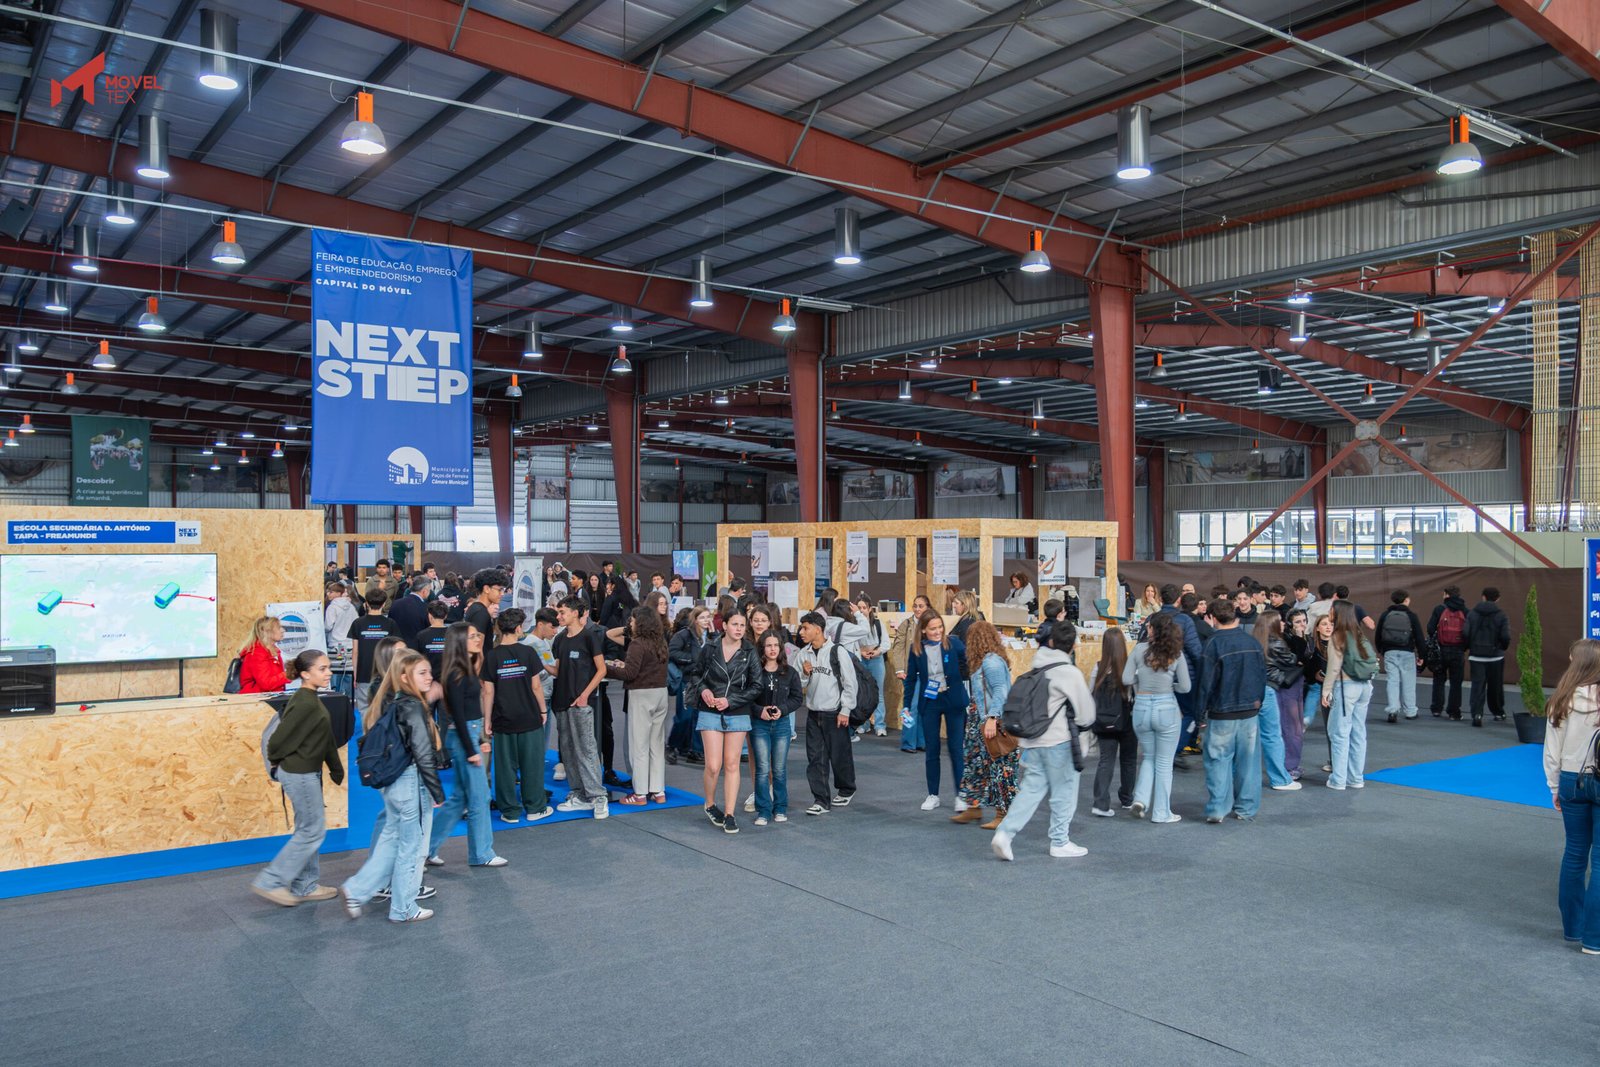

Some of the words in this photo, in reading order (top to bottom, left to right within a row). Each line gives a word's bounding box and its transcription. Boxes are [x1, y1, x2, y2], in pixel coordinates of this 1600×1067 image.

[316, 252, 344, 262] FEIRA
[346, 256, 359, 265] DE
[361, 257, 414, 273] EDUCAÇÃO,
[416, 265, 457, 277] EMPREGO
[316, 264, 322, 272] E
[325, 264, 423, 284] EMPREENDEDORISMO
[316, 278, 358, 289] CAPITAL
[362, 283, 375, 291] DO
[379, 284, 412, 295] MÓVEL
[316, 319, 460, 367] NEXT
[316, 359, 469, 405] STEP
[76, 476, 115, 484] Descobrir
[49, 523, 103, 532] SECUNDÁRIA
[114, 523, 151, 532] ANTÓNIO
